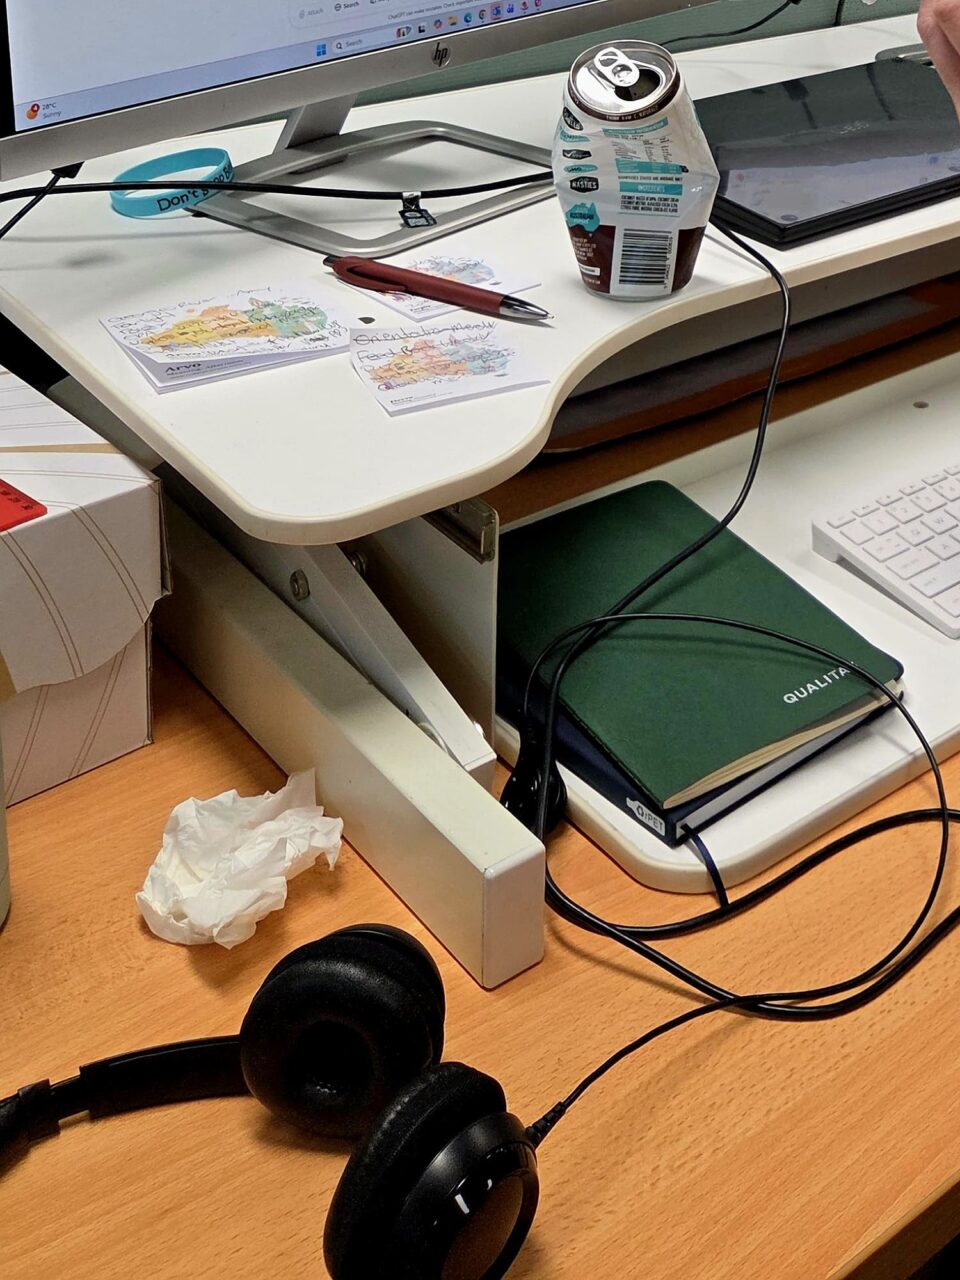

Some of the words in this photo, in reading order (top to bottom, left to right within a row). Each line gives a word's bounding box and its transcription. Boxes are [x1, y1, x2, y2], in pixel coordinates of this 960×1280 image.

[343, 0, 360, 10] Search
[345, 38, 363, 49] Search
[433, 42, 449, 67] hp
[571, 179, 597, 189] NASTIES
[156, 189, 200, 212] Don't
[783, 664, 852, 704] QUALITA
